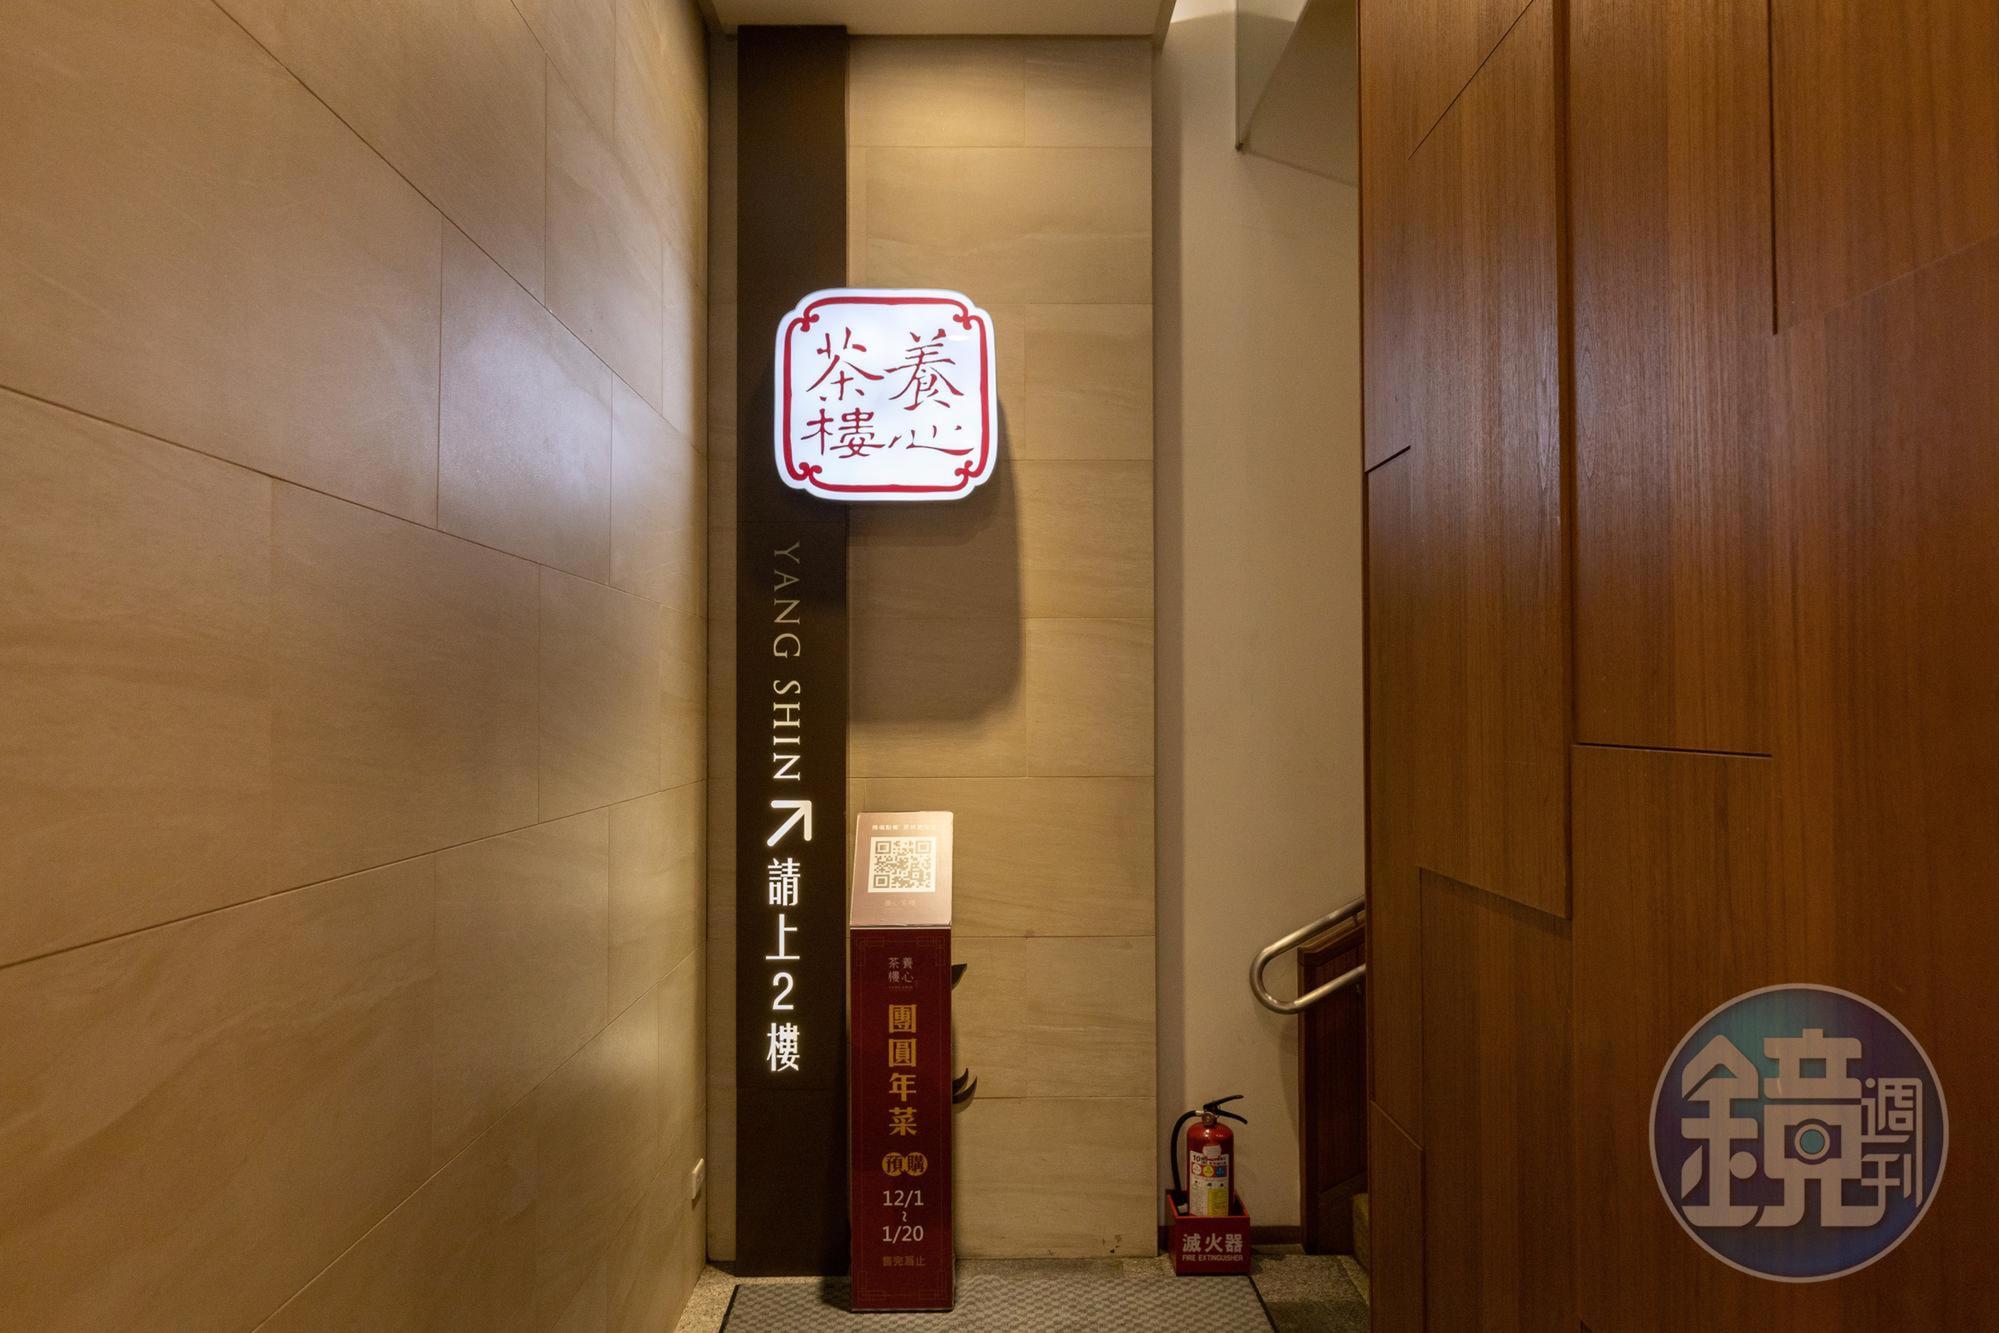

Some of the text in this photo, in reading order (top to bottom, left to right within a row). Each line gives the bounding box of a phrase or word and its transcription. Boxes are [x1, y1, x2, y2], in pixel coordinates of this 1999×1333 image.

[800, 326, 886, 459] 茶樓
[883, 328, 975, 456] 養心
[773, 541, 801, 781] YANG SHIN
[765, 857, 801, 1072] 請上2樓
[888, 1004, 917, 1136] 團圓年菜
[882, 1190, 924, 1208] 12/1
[883, 1152, 926, 1175] 預購
[881, 1225, 924, 1244] 1/20
[1182, 1232, 1243, 1253] 滅火器
[1182, 1254, 1243, 1262] FIRE EXTINGUISHER
